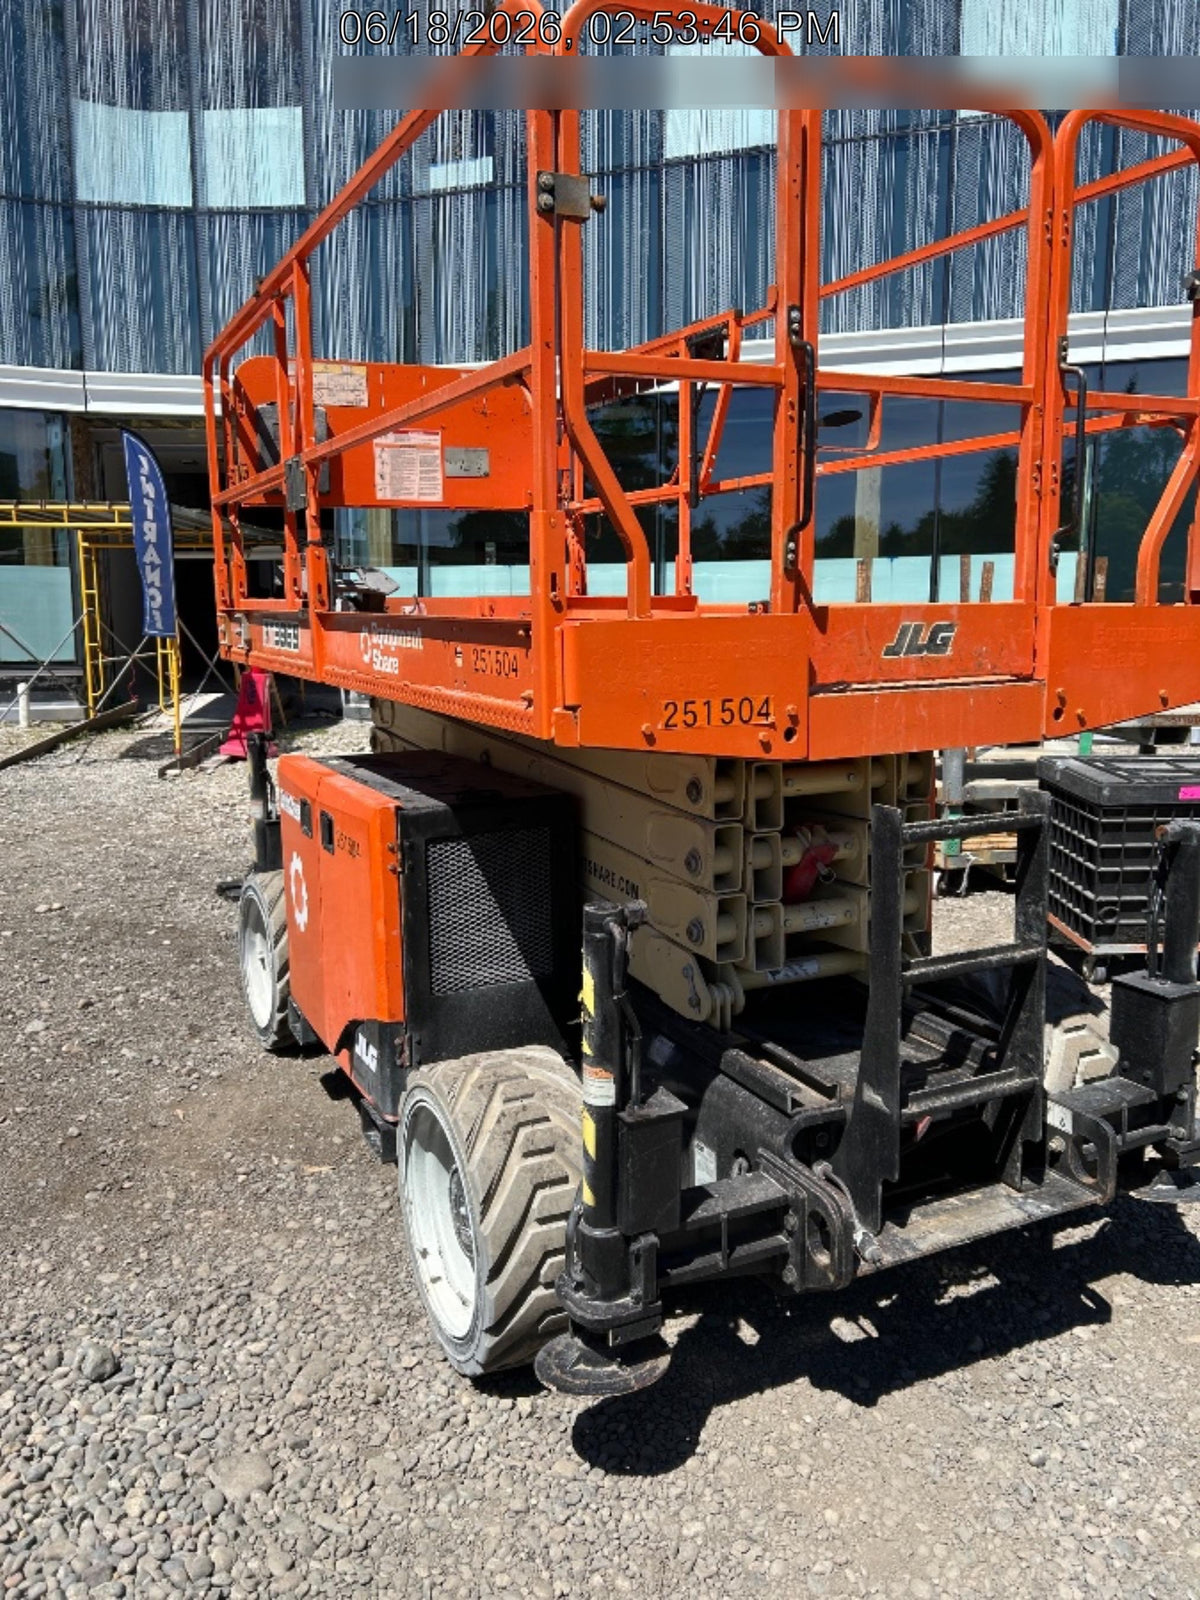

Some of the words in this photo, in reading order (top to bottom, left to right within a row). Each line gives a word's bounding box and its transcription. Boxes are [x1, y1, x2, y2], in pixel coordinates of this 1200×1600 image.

[370, 622, 424, 652] Equipment
[881, 621, 958, 659] JLG
[372, 647, 399, 675] Share
[472, 648, 519, 679] 251504
[664, 696, 772, 729] 251504
[354, 1032, 378, 1073] JLG
